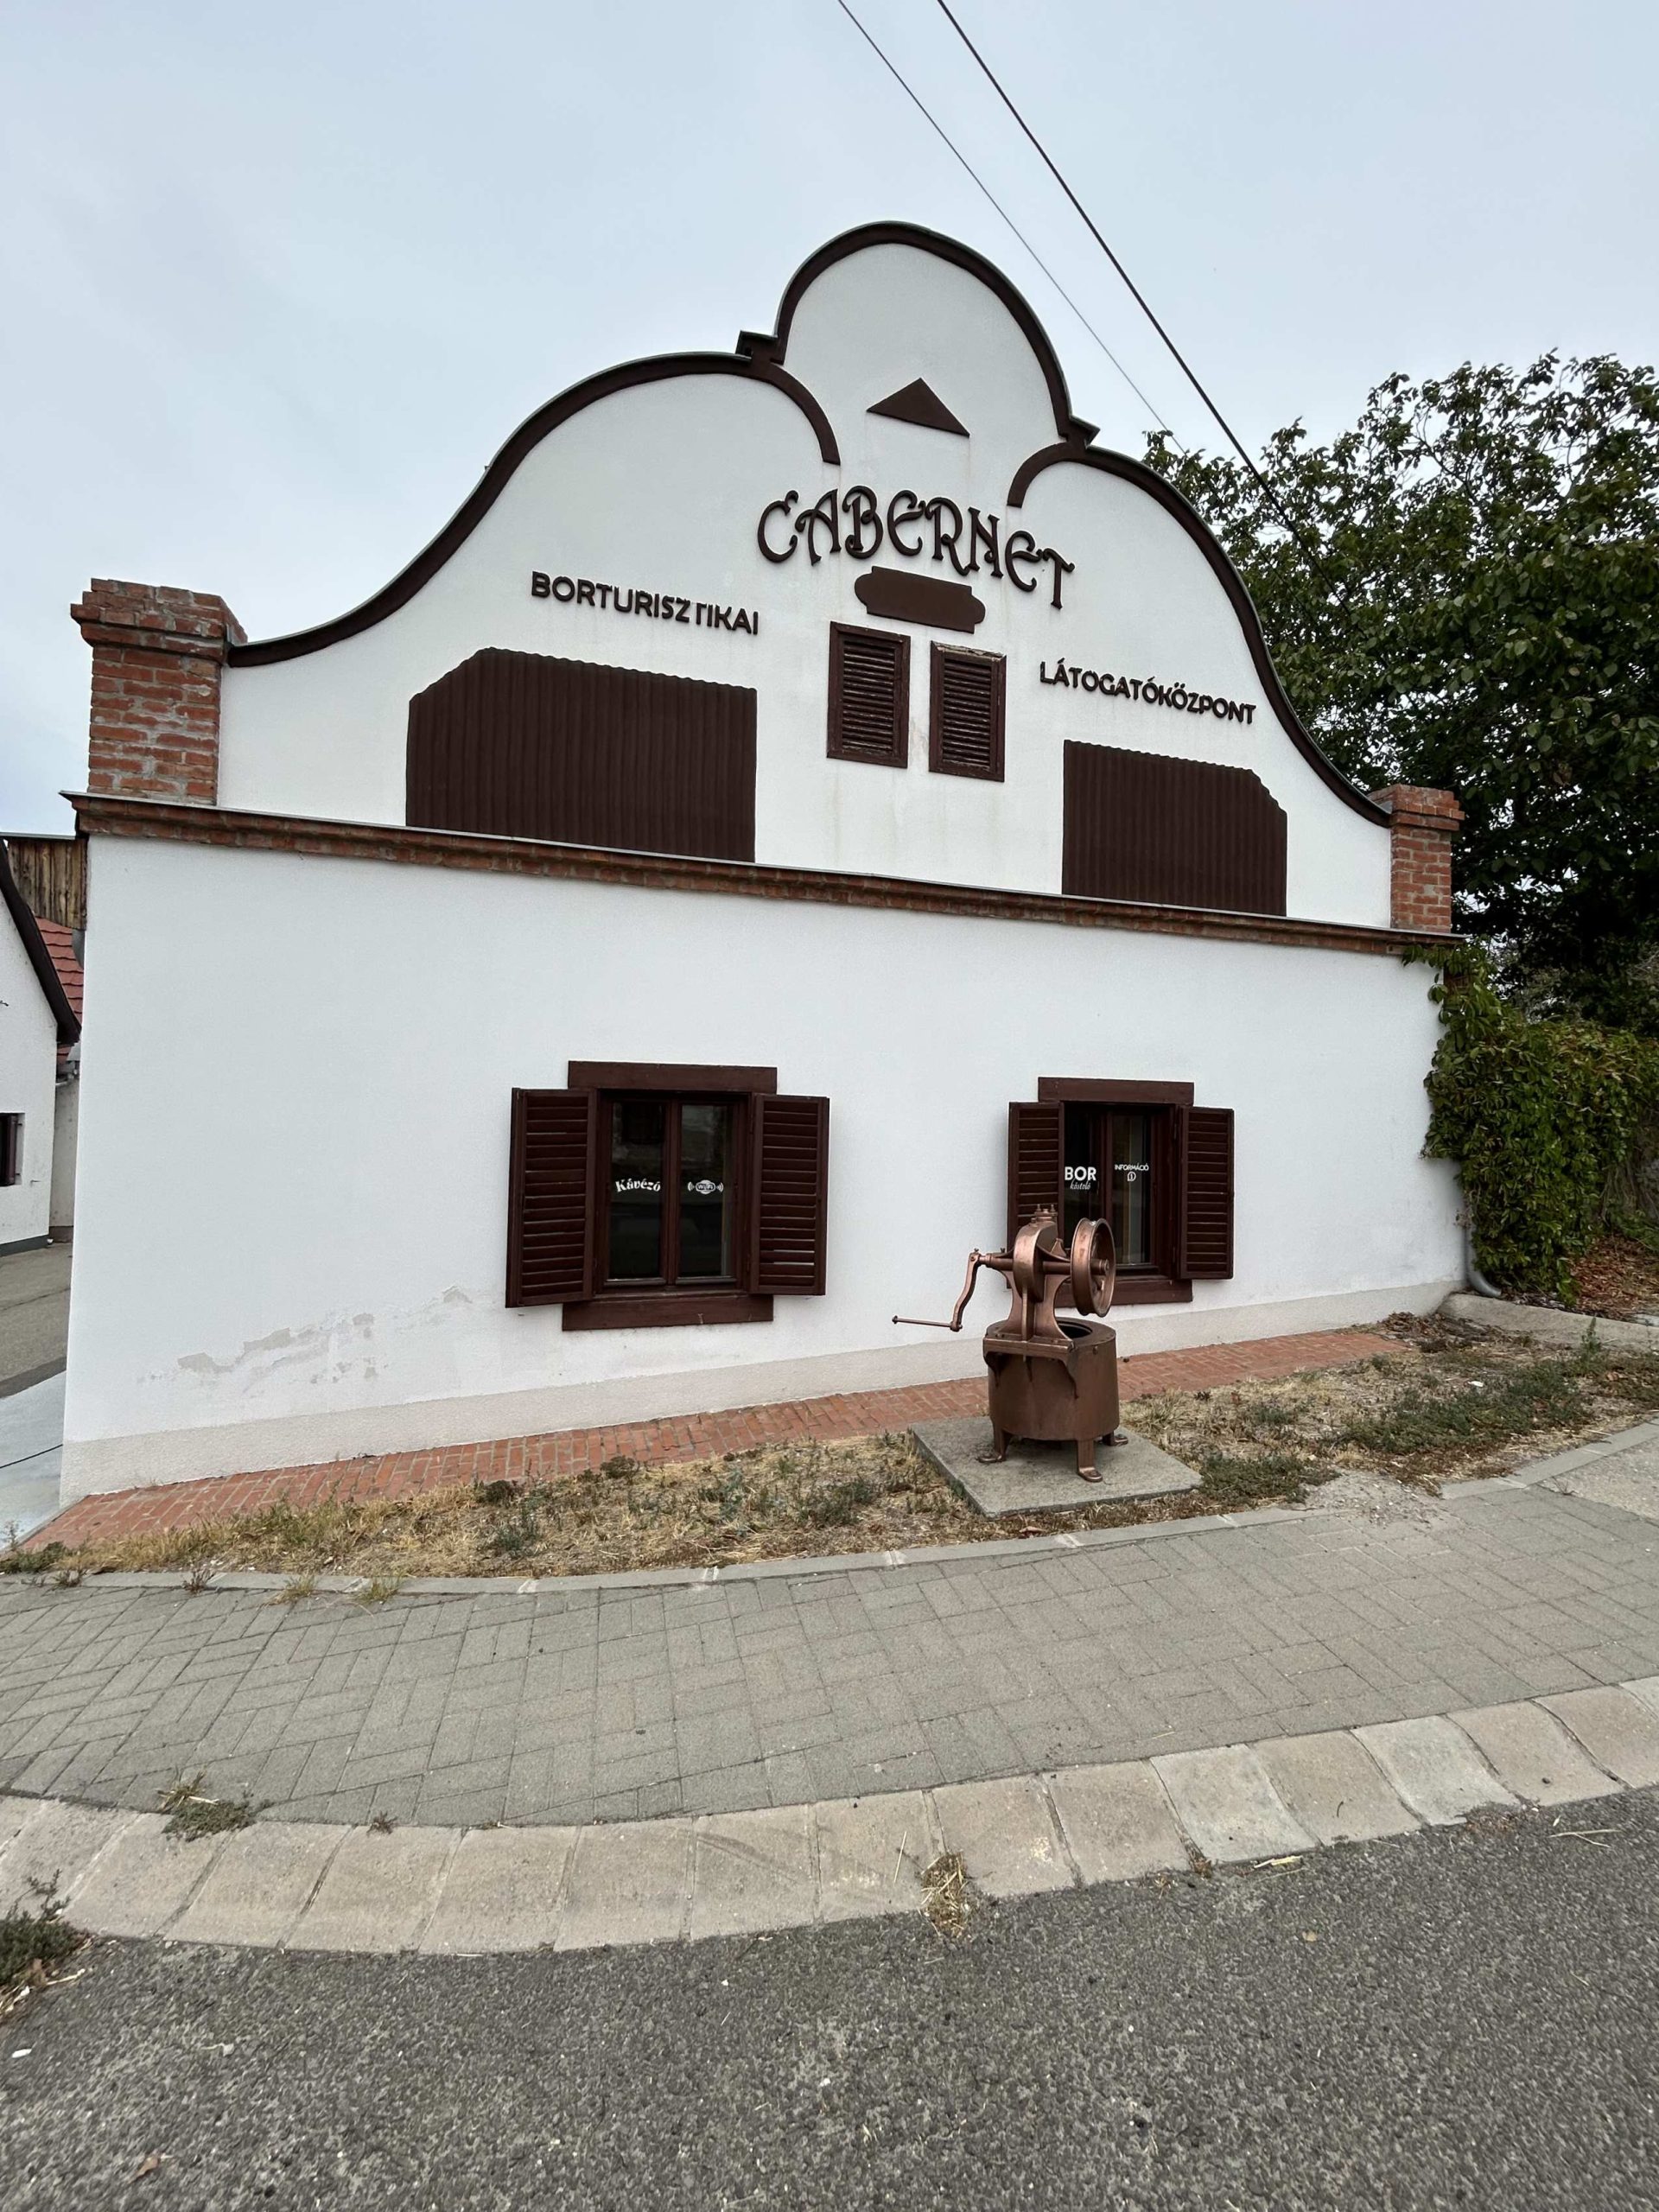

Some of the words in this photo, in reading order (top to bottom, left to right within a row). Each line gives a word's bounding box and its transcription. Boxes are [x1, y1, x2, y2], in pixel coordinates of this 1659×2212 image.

[757, 485, 1075, 610] CABERNET
[531, 570, 759, 635] BORTURISZTIKAI
[1039, 658, 1256, 724] LÁTOGATÓKÖZPONT
[615, 1178, 661, 1192] Kávézó
[1064, 1166, 1096, 1181] BOR
[1114, 1162, 1149, 1172] INFORMÁCIÓ
